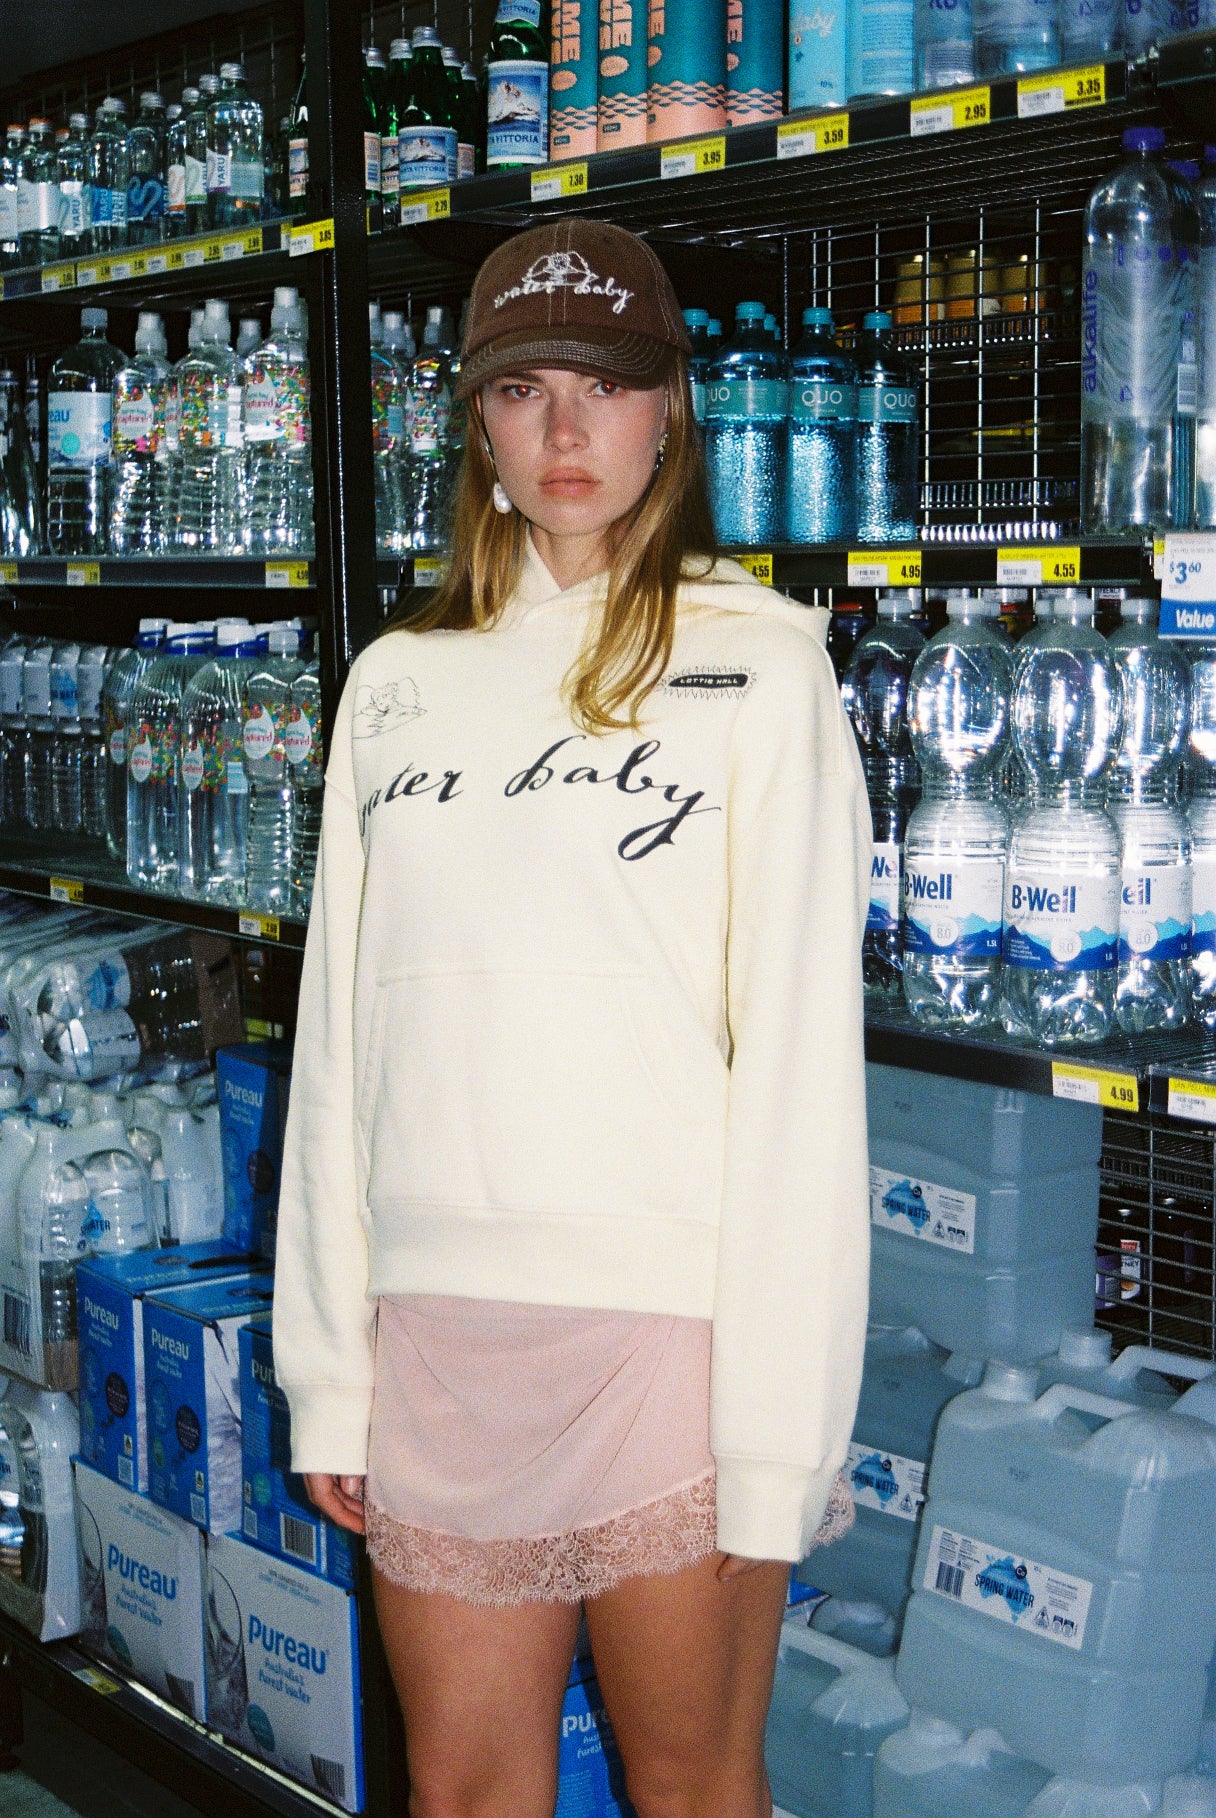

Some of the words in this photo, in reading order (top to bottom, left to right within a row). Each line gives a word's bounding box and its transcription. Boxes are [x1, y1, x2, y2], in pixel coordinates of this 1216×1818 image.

[1077, 79, 1101, 96] 3.35
[964, 103, 987, 122] 2.95
[823, 128, 845, 145] 3.59
[703, 150, 721, 166] 3.95
[434, 199, 448, 213] 2.79
[1082, 269, 1098, 394] alkalife
[801, 390, 843, 407] QUO
[900, 564, 921, 579] 4.95
[1053, 563, 1076, 578] 4.55
[1175, 608, 1216, 630] Value
[504, 735, 722, 862] baby
[224, 1079, 263, 1108] Pureau
[1110, 1086, 1134, 1103] 4.99
[84, 1296, 119, 1330] Pureau
[151, 1327, 189, 1361] Pureau
[108, 1543, 178, 1600] Pureau
[974, 1573, 1005, 1597] SPRING
[1005, 1584, 1035, 1608] WATER
[248, 1613, 327, 1675] Pureau
